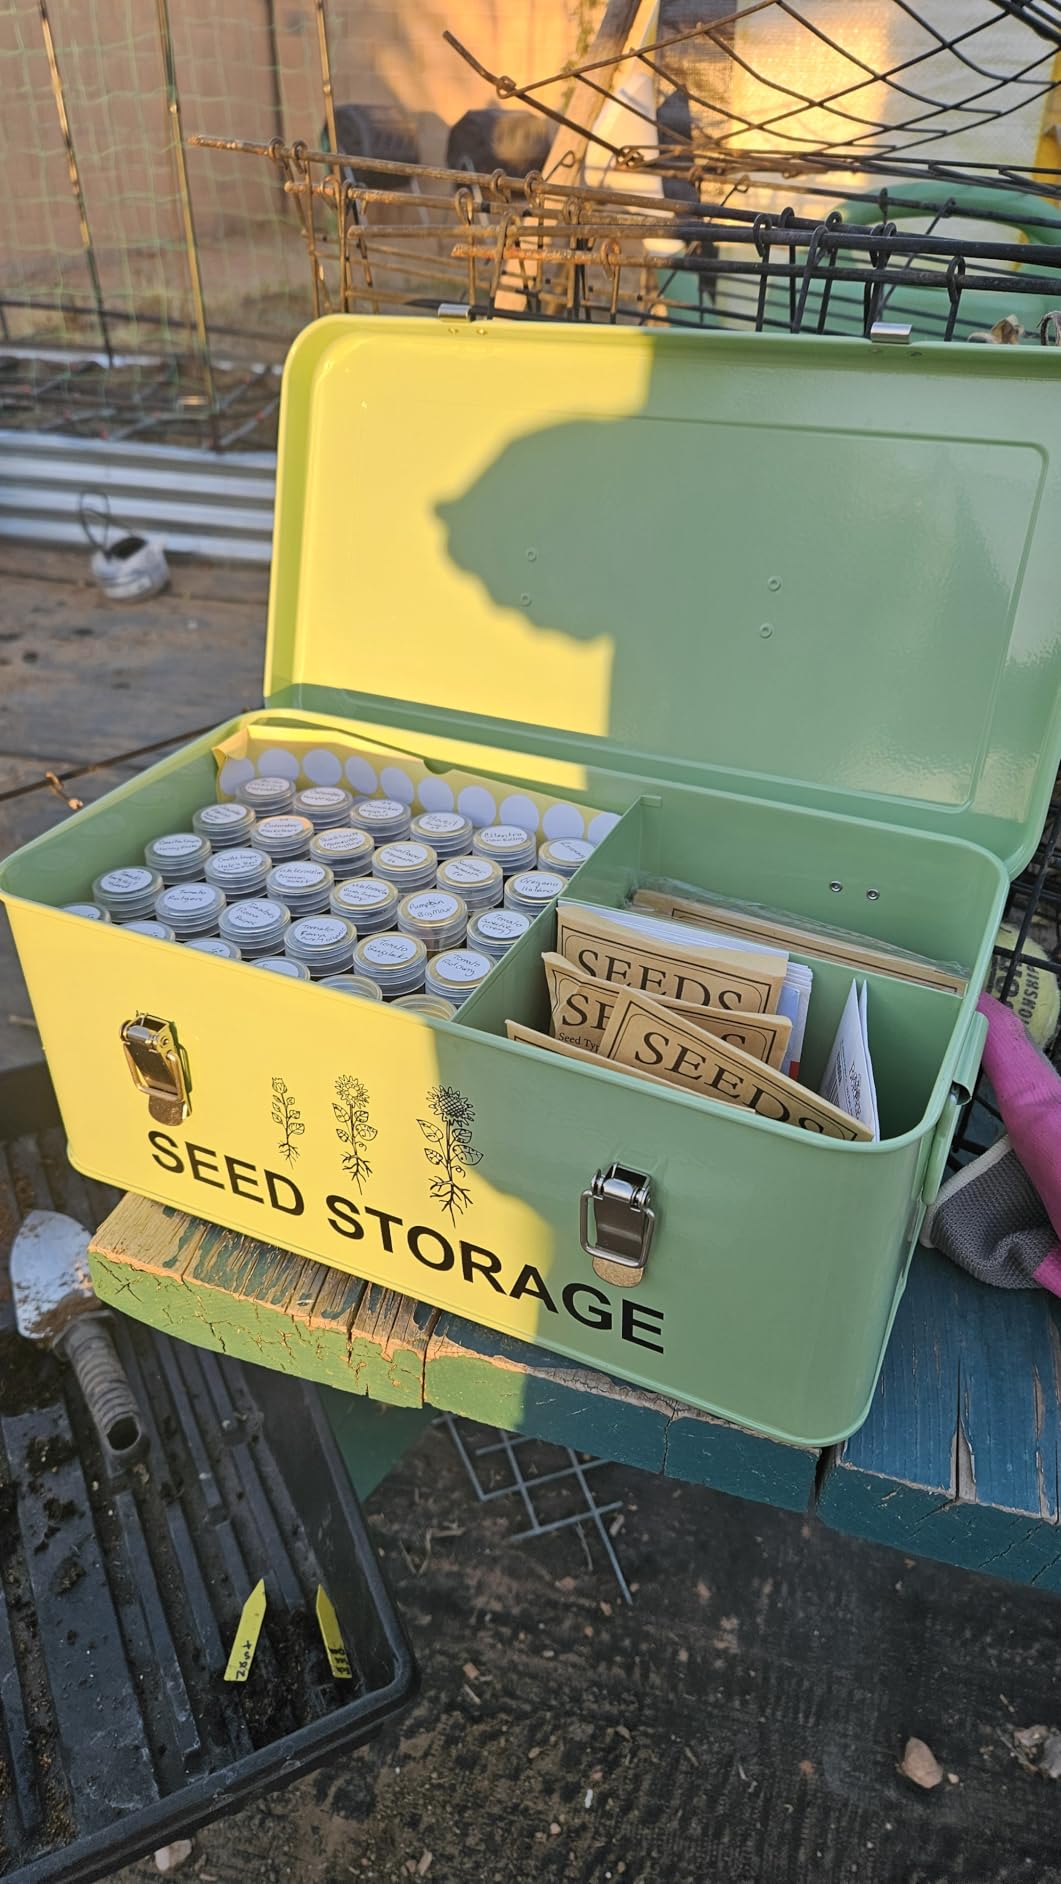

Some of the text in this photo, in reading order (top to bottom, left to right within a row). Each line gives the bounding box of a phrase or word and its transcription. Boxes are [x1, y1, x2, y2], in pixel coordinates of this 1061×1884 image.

[578, 949, 743, 1011] SEEDS
[559, 1032, 581, 1045] Seed
[148, 1129, 665, 1355] SEED STORAGE
